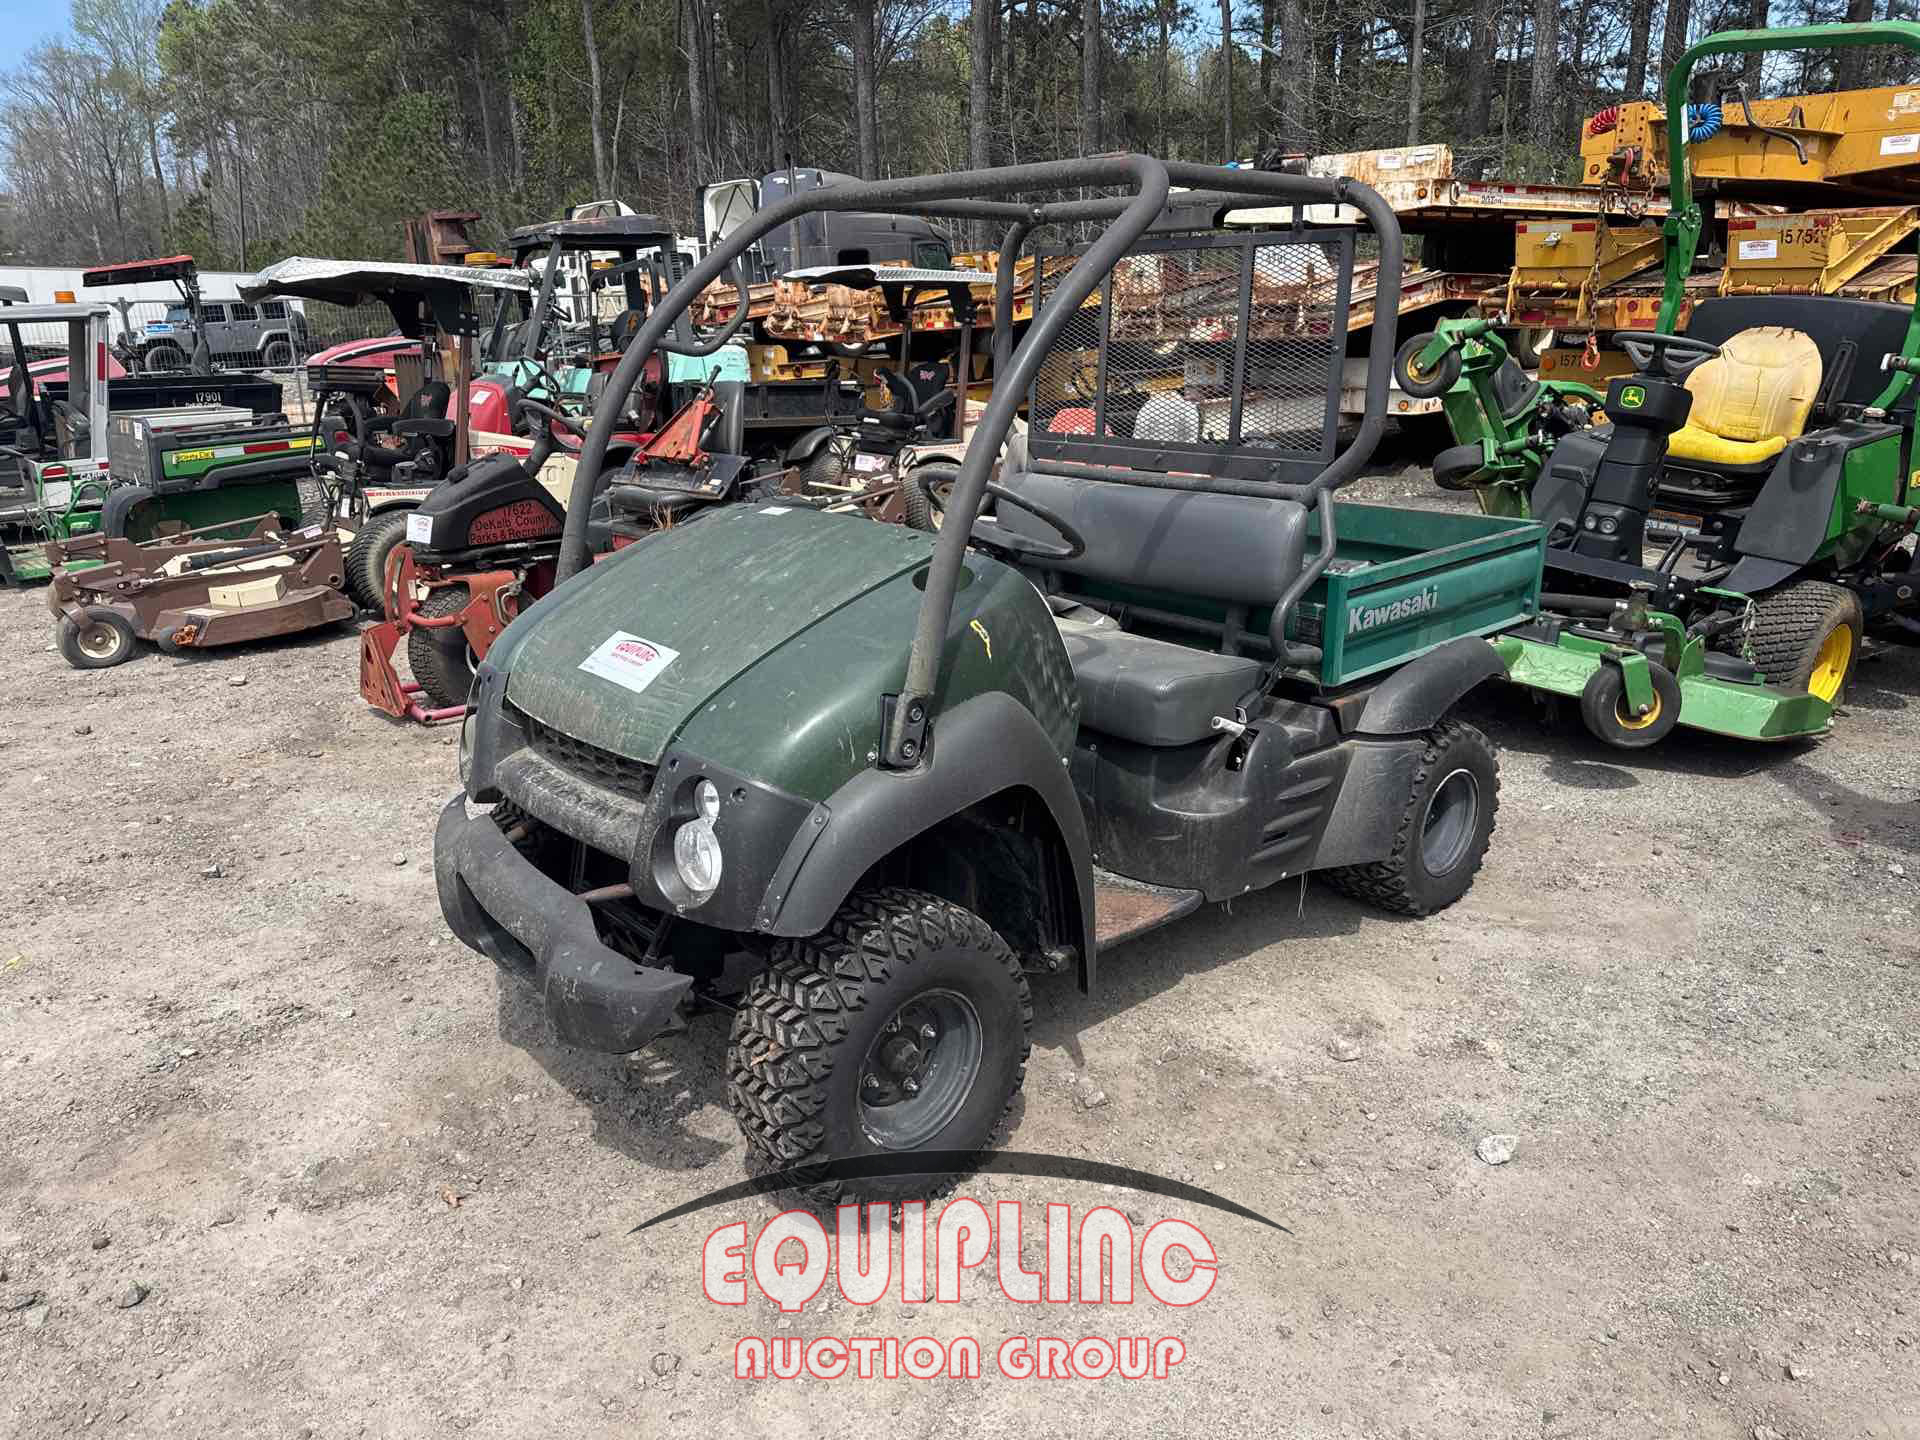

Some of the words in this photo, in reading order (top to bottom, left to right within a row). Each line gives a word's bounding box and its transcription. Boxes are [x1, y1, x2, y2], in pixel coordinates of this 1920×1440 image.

[195, 391, 222, 402] 17901
[474, 517, 512, 531] DeKalb
[471, 532, 498, 545] Parks
[1348, 584, 1438, 635] Kawasaki
